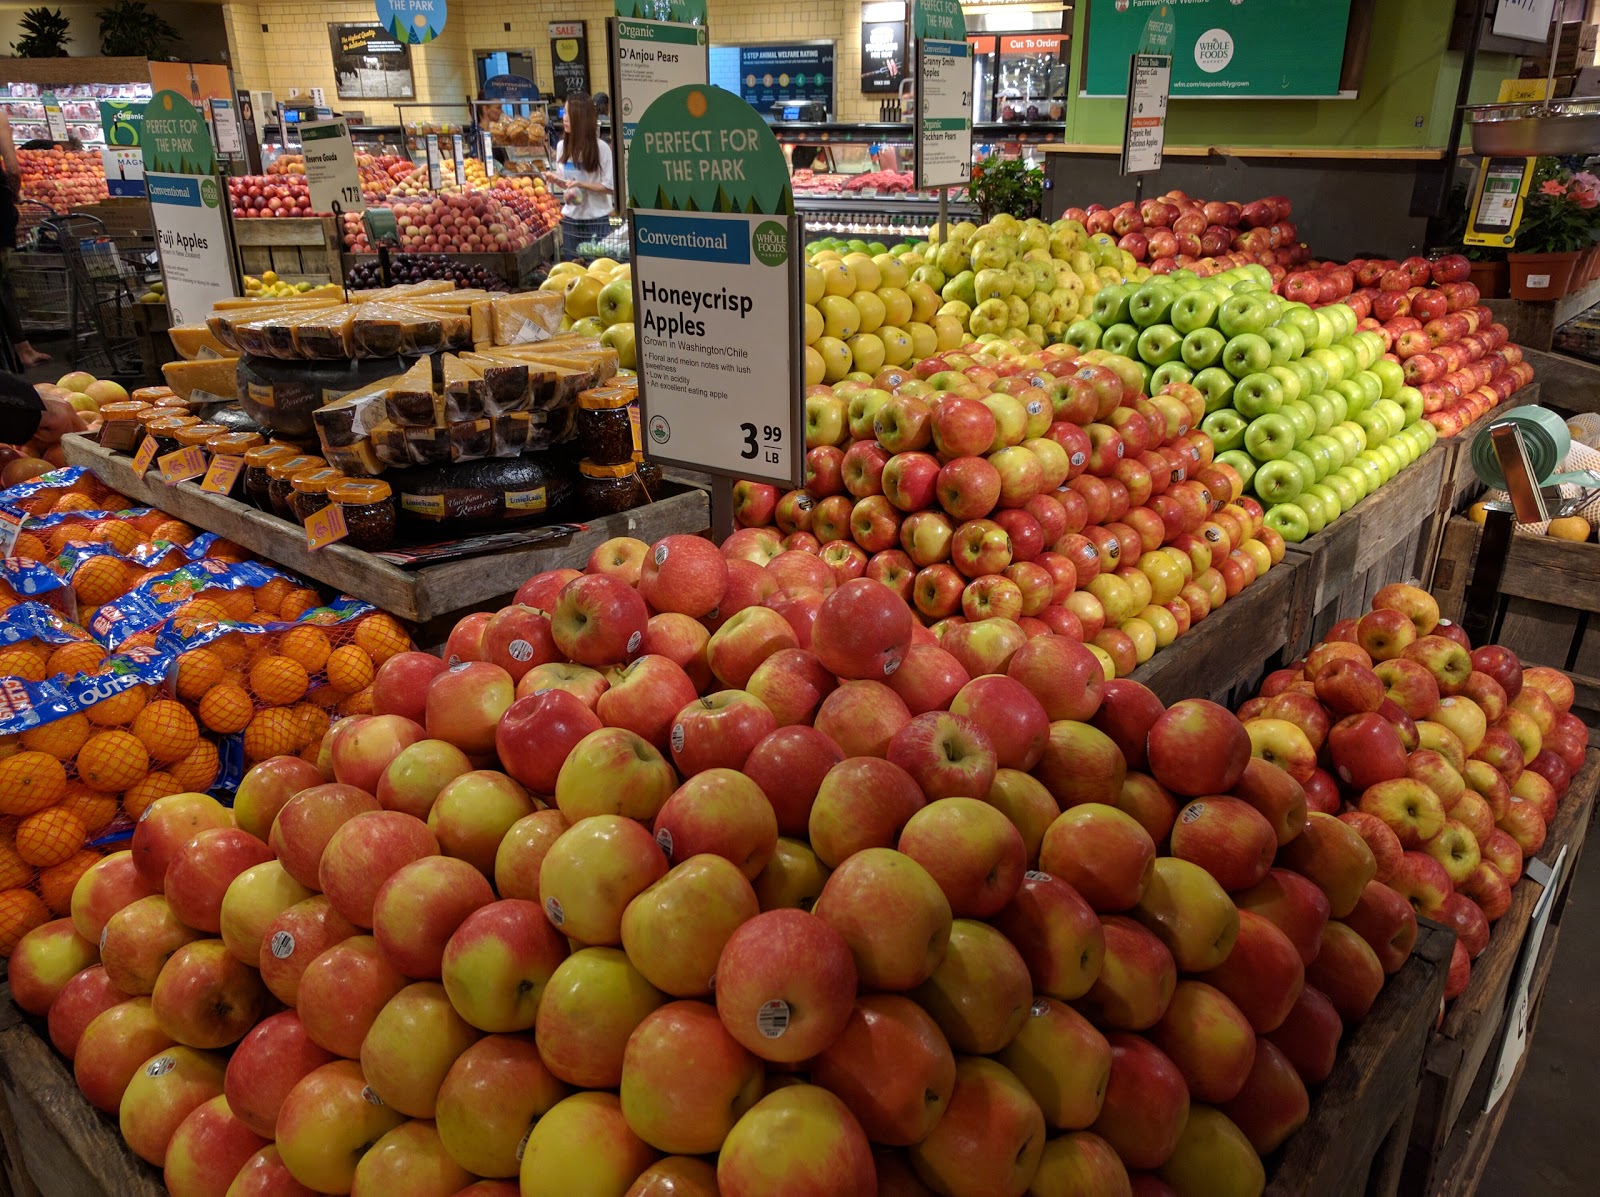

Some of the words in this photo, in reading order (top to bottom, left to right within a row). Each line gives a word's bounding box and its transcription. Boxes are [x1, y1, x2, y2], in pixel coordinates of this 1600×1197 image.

[409, 0, 435, 11] PARK
[946, 1, 958, 14] FOR
[926, 14, 937, 27] THE
[939, 15, 953, 29] PARK
[1164, 22, 1173, 34] FOR
[555, 26, 576, 35] SALE
[618, 23, 655, 39] Organic
[1010, 40, 1024, 48] Cut
[1025, 39, 1035, 48] To
[1036, 38, 1059, 47] Order
[1158, 35, 1167, 46] PARK
[1200, 42, 1230, 51] WHOLE
[620, 47, 655, 63] D'Anjou
[657, 50, 679, 63] Pears
[747, 52, 759, 60] STEP
[923, 57, 942, 67] Granny
[1200, 50, 1229, 59] FOODS
[1173, 80, 1250, 89] wfm.com/responsiblygrown
[962, 91, 967, 106] 2
[117, 110, 144, 121] Organic
[146, 119, 176, 134] PERFECT
[180, 119, 198, 134] FOR
[155, 138, 170, 153] THE
[171, 138, 194, 153] PARK
[644, 130, 712, 154] PERFECT
[719, 128, 759, 152] FOR
[662, 160, 693, 182] THE
[699, 158, 746, 182] PARK
[960, 162, 965, 177] 2
[148, 183, 191, 198] Conventional
[341, 187, 353, 203] 17
[158, 229, 174, 249] Fuji
[176, 232, 208, 251] Apples
[637, 227, 728, 250] Conventional
[756, 232, 787, 243] WHOLE
[757, 242, 787, 253] FOODS
[641, 280, 753, 318] Honeycrisp
[643, 309, 706, 338] Apples
[643, 335, 668, 348] Grown
[669, 341, 676, 349] in
[677, 340, 748, 359] Washington/Chile
[645, 362, 677, 373] sweetness
[648, 352, 666, 362] Floral
[666, 356, 679, 364] and
[679, 358, 700, 367] melon
[701, 361, 719, 370] notes
[720, 363, 735, 372] with
[736, 364, 752, 374] lush
[649, 371, 662, 379] Low
[663, 372, 669, 380] in
[670, 375, 691, 386] acidity
[650, 380, 659, 388] An
[660, 382, 687, 393] excellent
[688, 387, 708, 398] eating
[709, 391, 728, 400] apple
[739, 422, 760, 460] 3
[763, 425, 783, 442] 99
[765, 451, 780, 464] LB
[455, 497, 500, 518] Reserve
